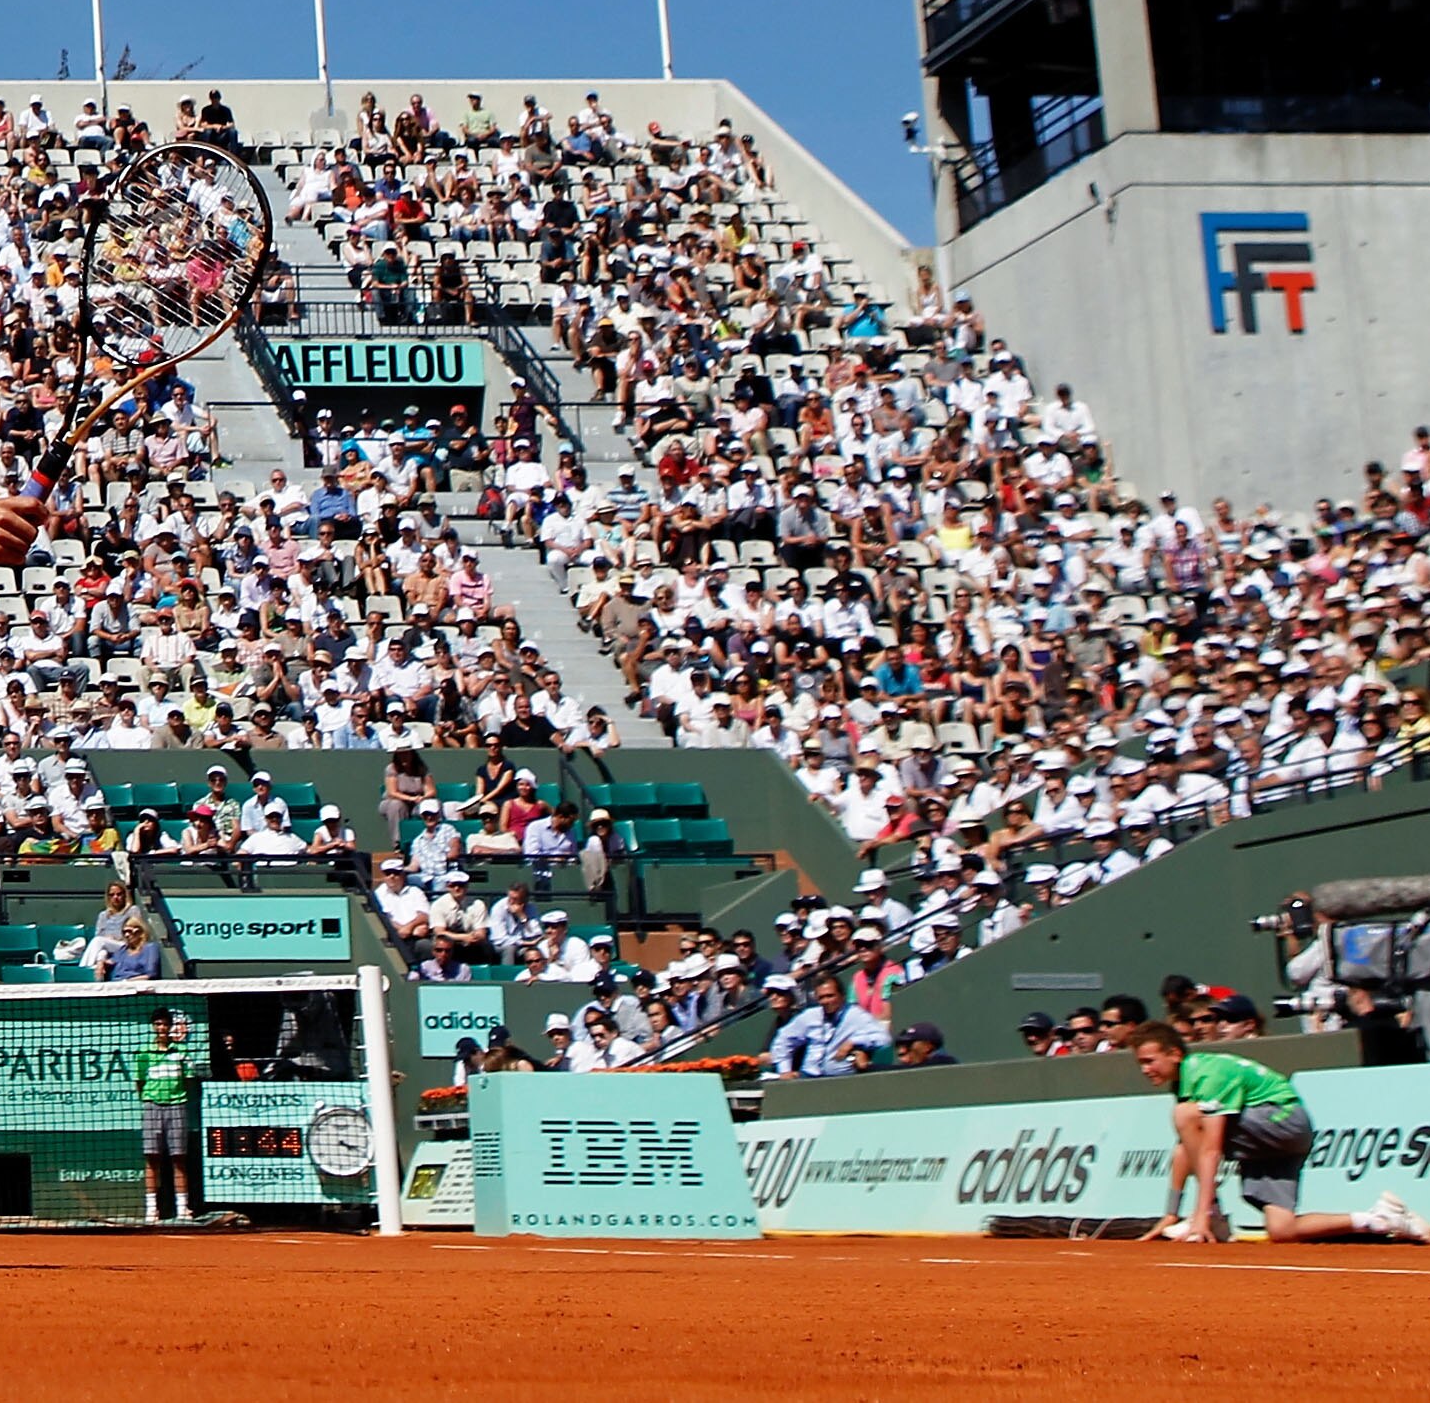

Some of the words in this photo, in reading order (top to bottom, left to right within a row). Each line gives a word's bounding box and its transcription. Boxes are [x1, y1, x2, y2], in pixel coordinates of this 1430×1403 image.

[1200, 212, 1316, 334] FFT
[274, 345, 464, 383] AFFLELOU
[247, 919, 316, 937] sport
[425, 1011, 500, 1030] adidas
[207, 1094, 303, 1108] LONGINES
[541, 1120, 703, 1186] IBM
[209, 1167, 305, 1182] LONGINES
[957, 1127, 1096, 1204] adidas
[94, 1169, 145, 1182] PARIBA
[511, 1213, 757, 1228] ROLANDGARROS.COM
